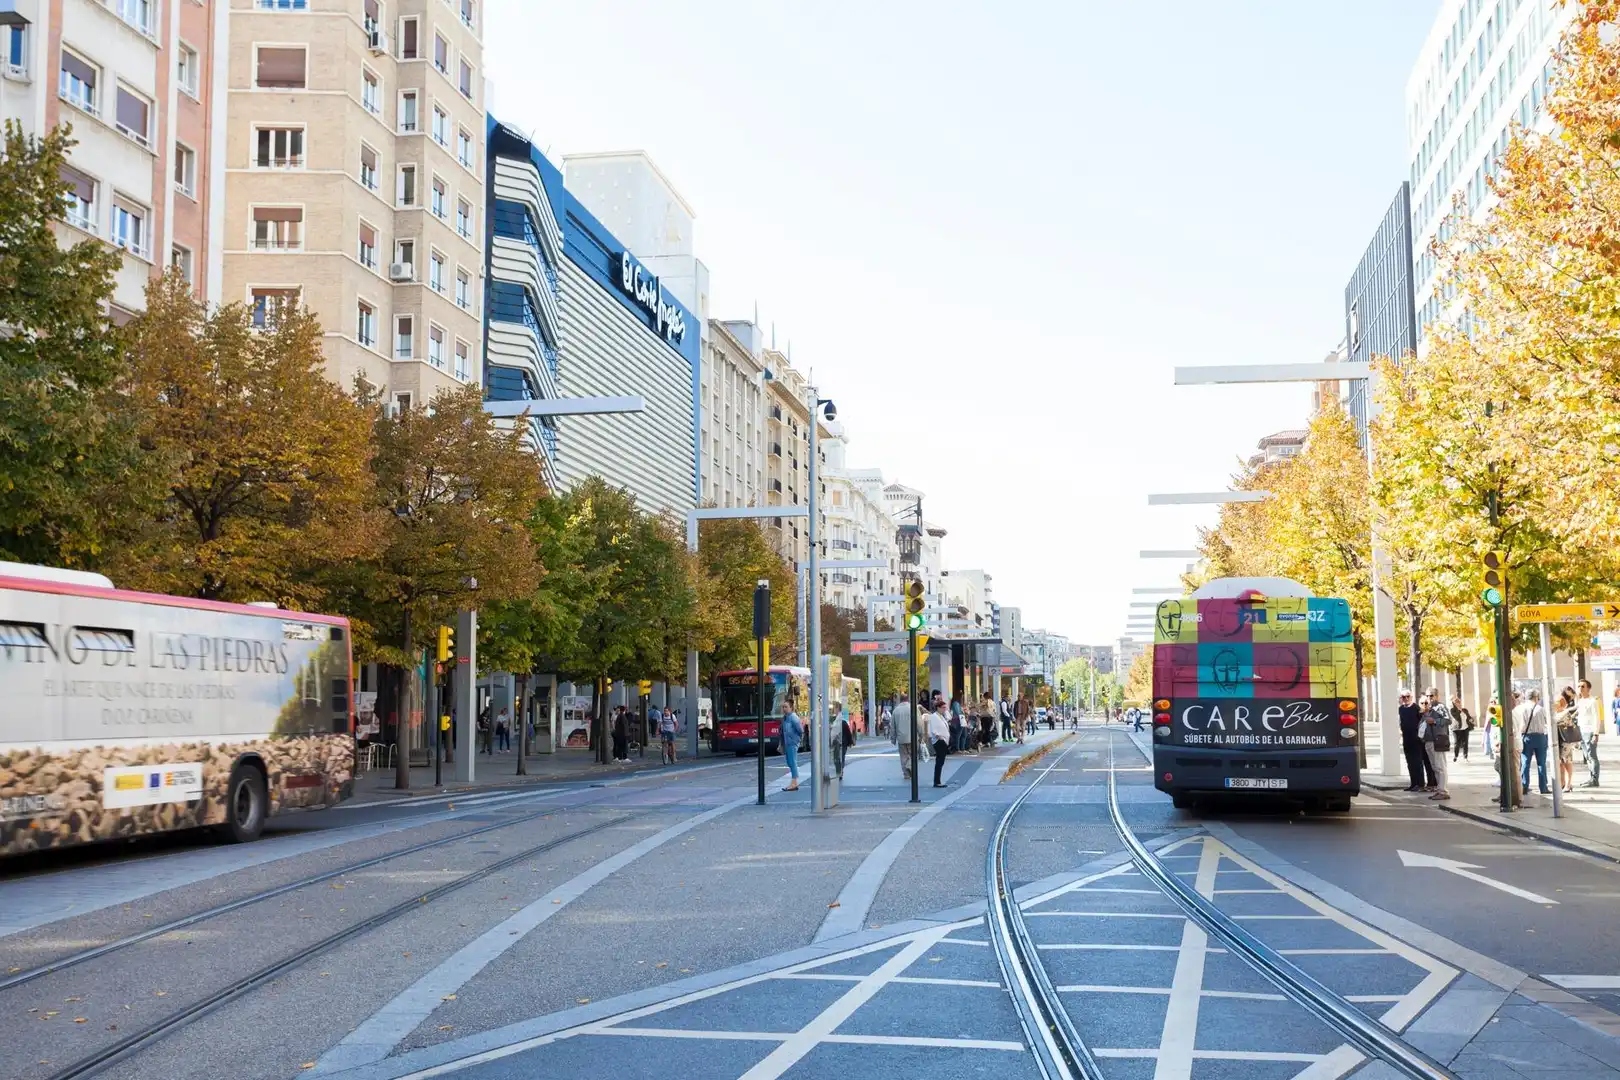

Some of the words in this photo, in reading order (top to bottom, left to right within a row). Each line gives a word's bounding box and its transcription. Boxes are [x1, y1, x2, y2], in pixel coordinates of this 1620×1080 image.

[622, 250, 634, 293] El
[635, 264, 657, 314] Corte
[1243, 612, 1260, 625] 21
[1519, 610, 1541, 618] GOYA
[98, 629, 137, 667] DE
[149, 631, 191, 670] LAS
[198, 636, 289, 675] PIEDRAS
[1282, 701, 1330, 729] Bus
[1184, 734, 1212, 744] SÚBETE
[1214, 735, 1224, 744] AL
[1225, 734, 1260, 745] AUTOBÚS
[1262, 735, 1272, 745] DE
[1274, 735, 1284, 745] LA
[1285, 735, 1327, 745] GARNACHA
[1231, 779, 1250, 787] 3800
[1252, 779, 1267, 787] JTY
